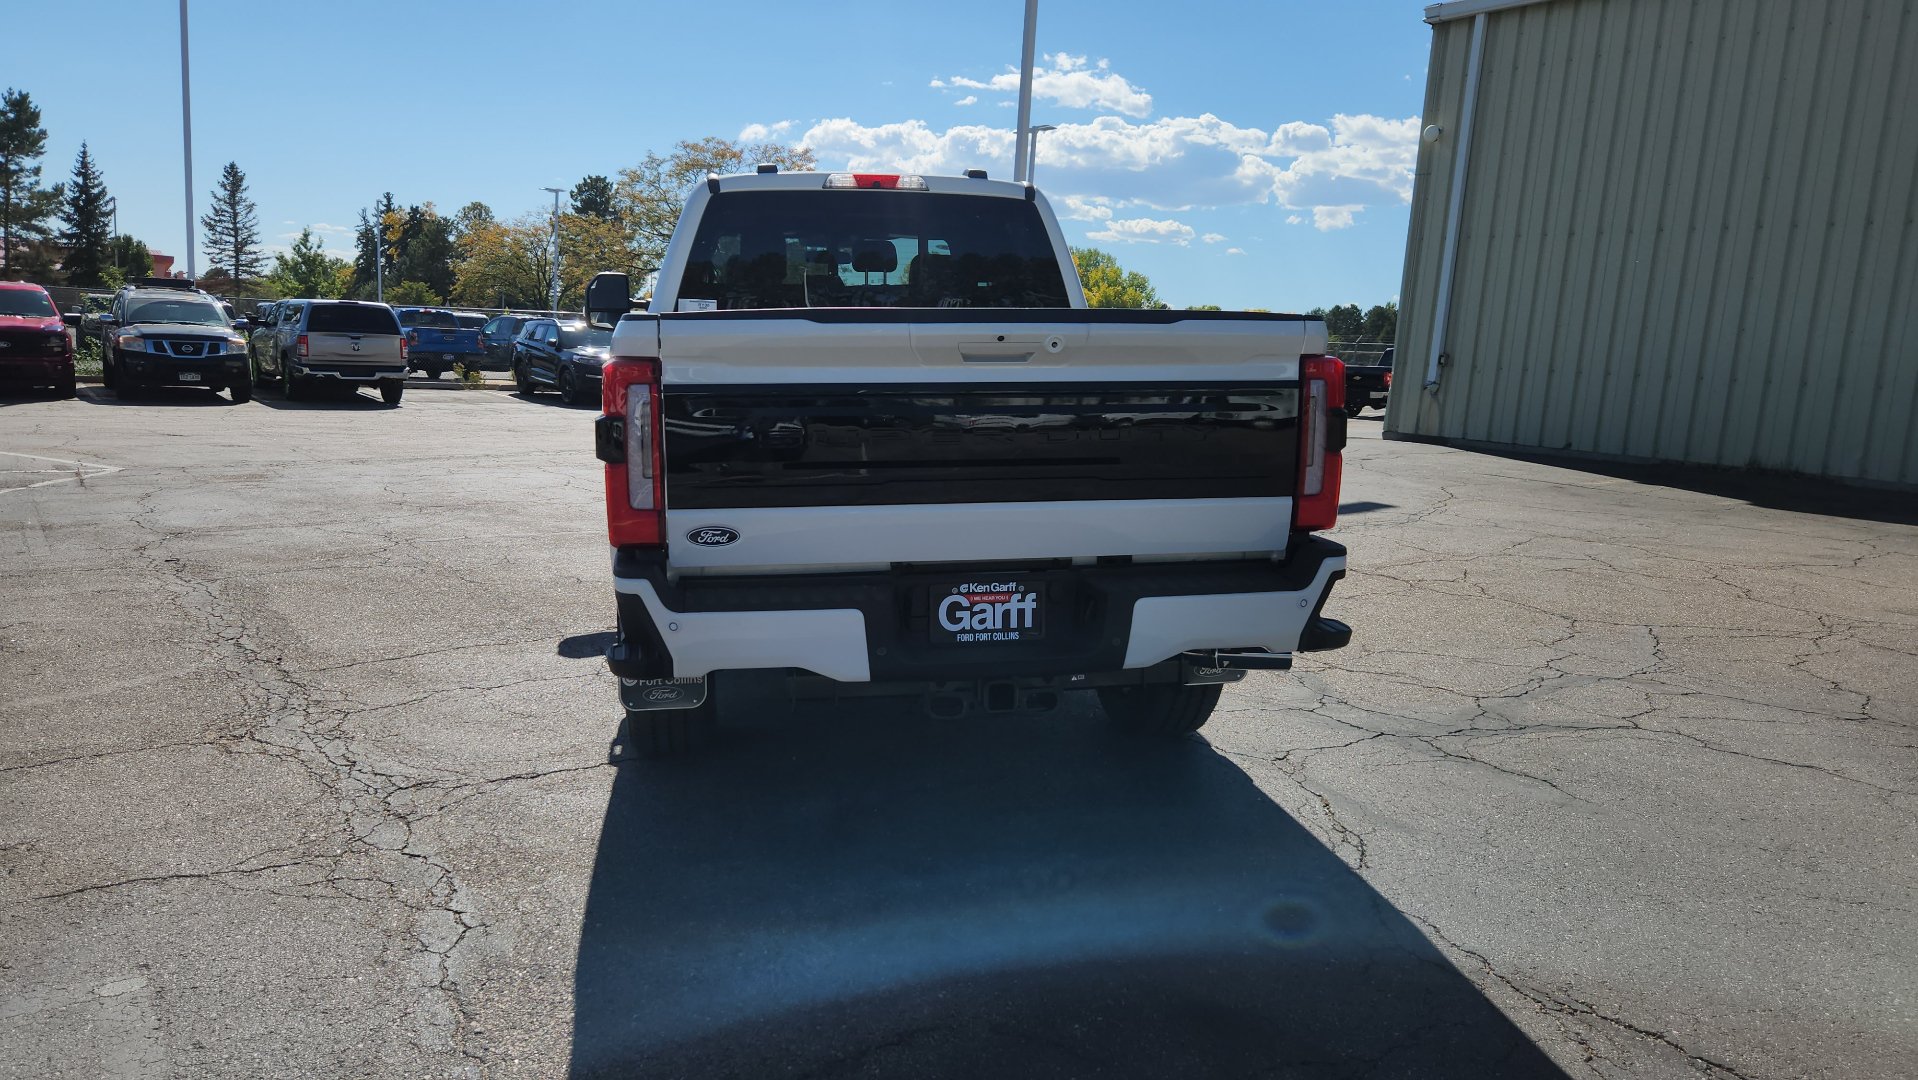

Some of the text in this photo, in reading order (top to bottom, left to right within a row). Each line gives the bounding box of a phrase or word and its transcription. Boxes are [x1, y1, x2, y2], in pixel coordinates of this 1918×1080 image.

[697, 530, 730, 543] Ford
[970, 581, 1017, 593] Ken Garff
[938, 592, 1037, 632] Garff
[957, 631, 1020, 642] FORD FORT COLLINS
[649, 688, 678, 700] Ford
